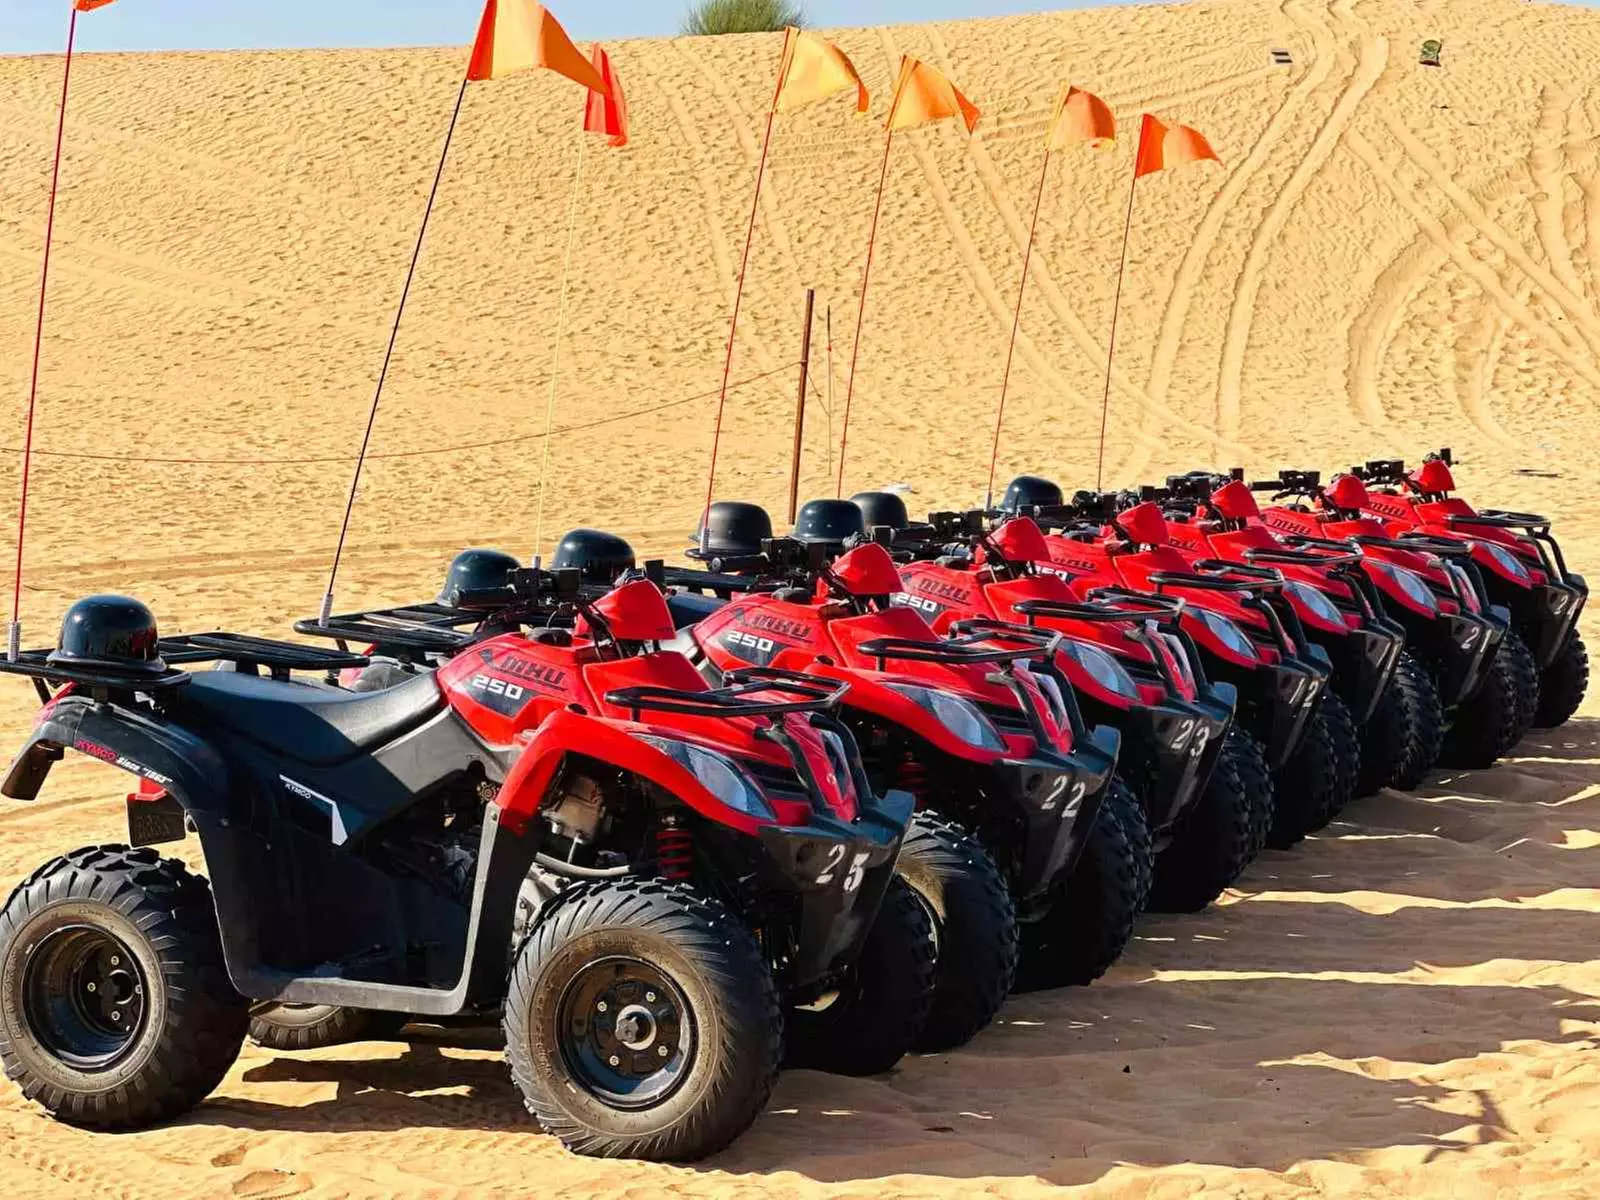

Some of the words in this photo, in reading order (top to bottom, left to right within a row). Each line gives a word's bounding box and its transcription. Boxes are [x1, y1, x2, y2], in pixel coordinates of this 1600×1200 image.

[895, 592, 937, 612] 250
[727, 630, 774, 652] 250
[1461, 626, 1492, 653] 21
[472, 674, 524, 700] 250
[1288, 677, 1319, 707] 12
[1171, 719, 1210, 757] 23
[1041, 775, 1086, 818] 22
[815, 844, 870, 891] 25
